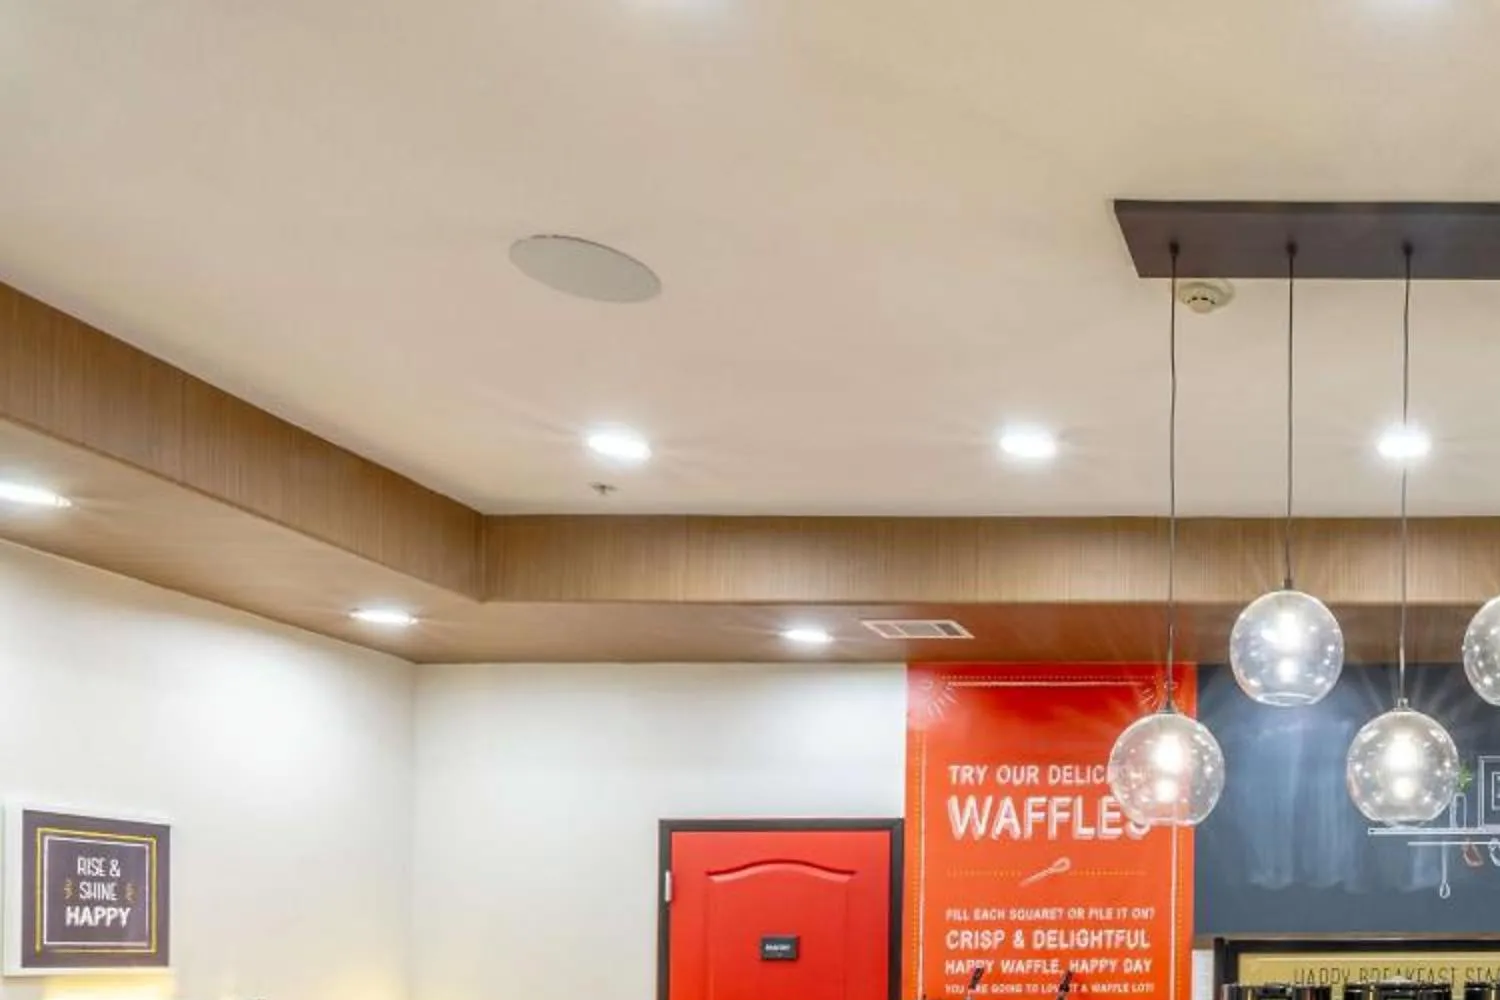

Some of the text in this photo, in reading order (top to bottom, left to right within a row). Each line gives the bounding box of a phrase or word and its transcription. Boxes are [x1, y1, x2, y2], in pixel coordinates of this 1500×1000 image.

[948, 765, 989, 785] TRY
[997, 765, 1040, 785] OUR
[77, 856, 121, 877] RISE &
[79, 881, 119, 900] SHINE
[65, 905, 131, 928] HAPPY
[945, 907, 969, 920] FILL
[974, 907, 1005, 920] EACH
[1067, 907, 1085, 920] OR
[1088, 907, 1113, 920] PILE
[1116, 907, 1128, 920] IT
[945, 929, 1151, 950] CRISP & DELIGHTFUL
[945, 959, 995, 975] HAPPY
[1069, 959, 1118, 974] HAPPY
[1123, 958, 1153, 974] DAY
[968, 983, 988, 994] RE
[1026, 983, 1039, 994] TO
